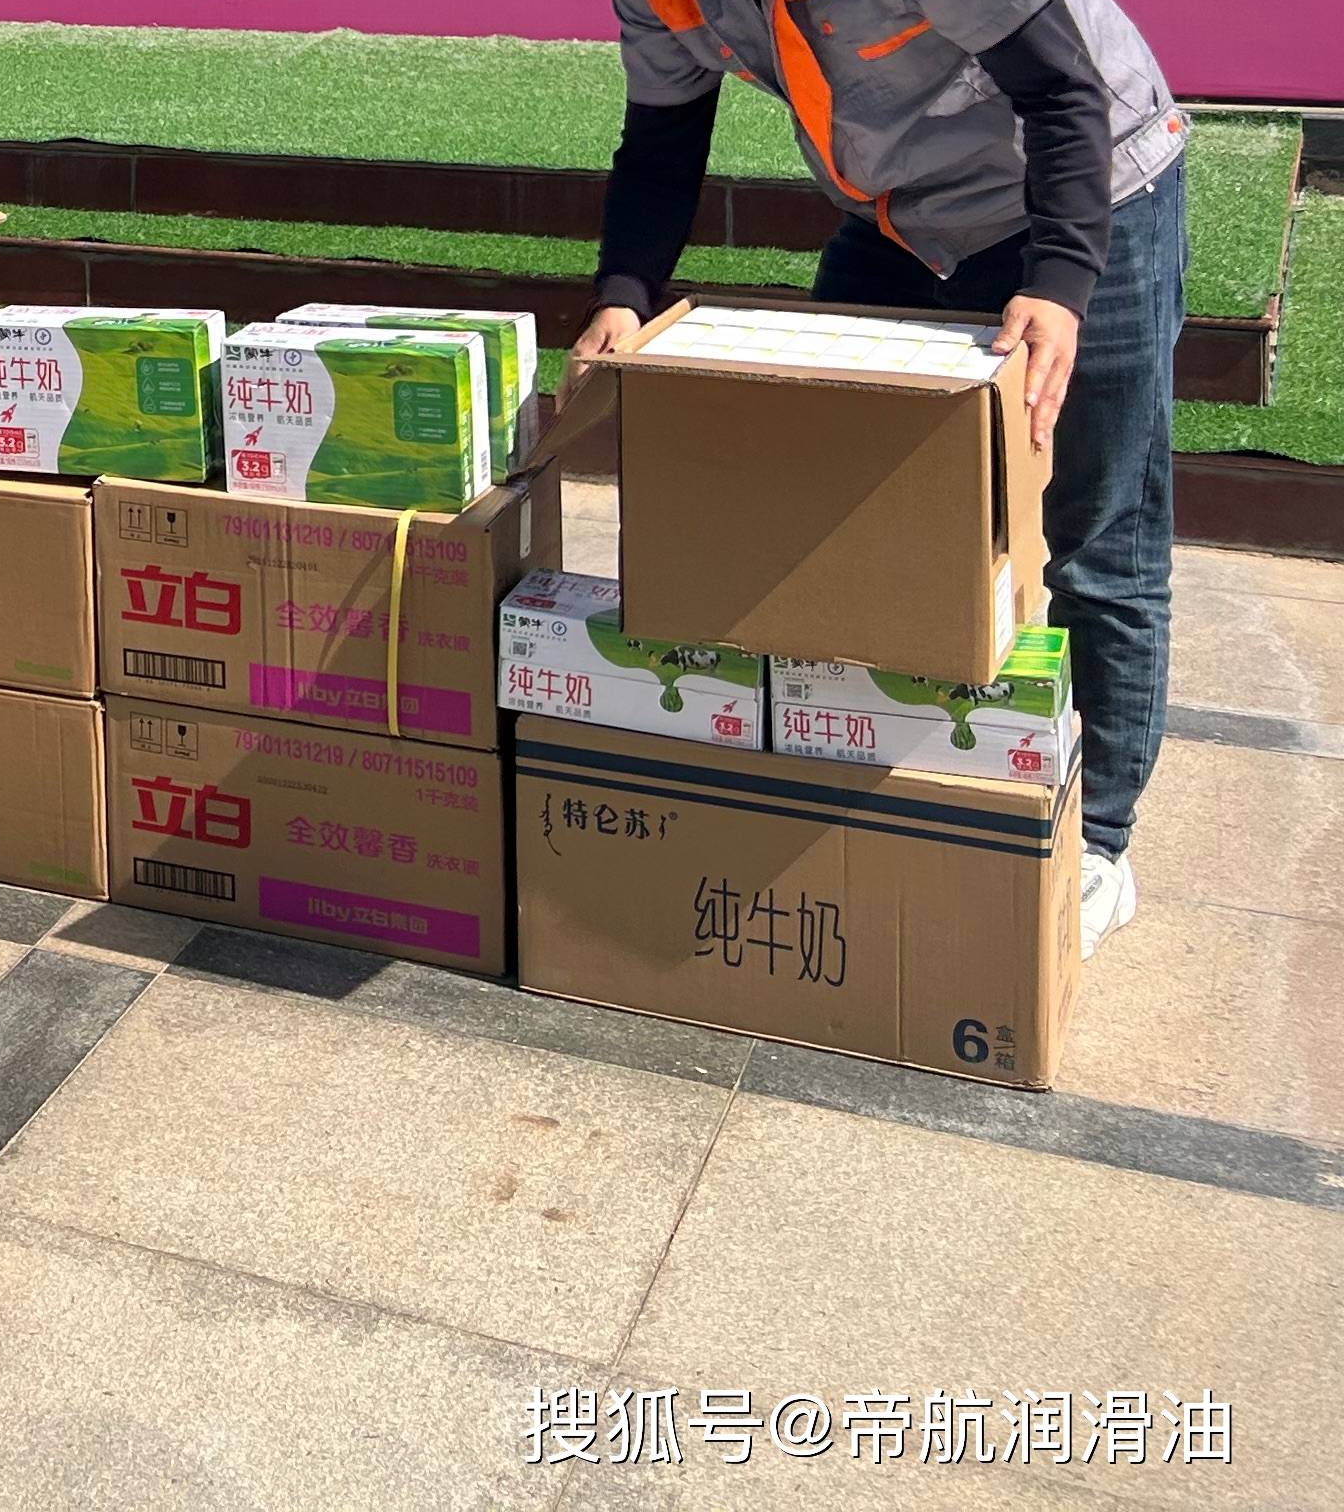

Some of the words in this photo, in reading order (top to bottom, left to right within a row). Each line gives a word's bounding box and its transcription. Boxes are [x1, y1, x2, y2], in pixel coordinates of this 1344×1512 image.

[245, 347, 273, 363] 蒙牛
[227, 376, 312, 414] 纯牛奶
[223, 514, 332, 548] 79101131219
[352, 529, 467, 563] 8071515109
[120, 564, 242, 636] 立白
[518, 616, 544, 631] 蒙牛
[508, 663, 592, 707] 纯牛奶
[783, 707, 875, 748] 纯牛奶
[232, 729, 343, 767] 79101131219
[362, 749, 478, 788] 80711515109
[131, 775, 252, 849] 立白
[415, 788, 479, 813] 1千克装
[562, 797, 651, 840] 特仑苏
[286, 815, 417, 864] 全效馨香
[426, 852, 480, 878] 洗衣液
[693, 876, 847, 988] 纯牛奶
[952, 1018, 990, 1064] 6
